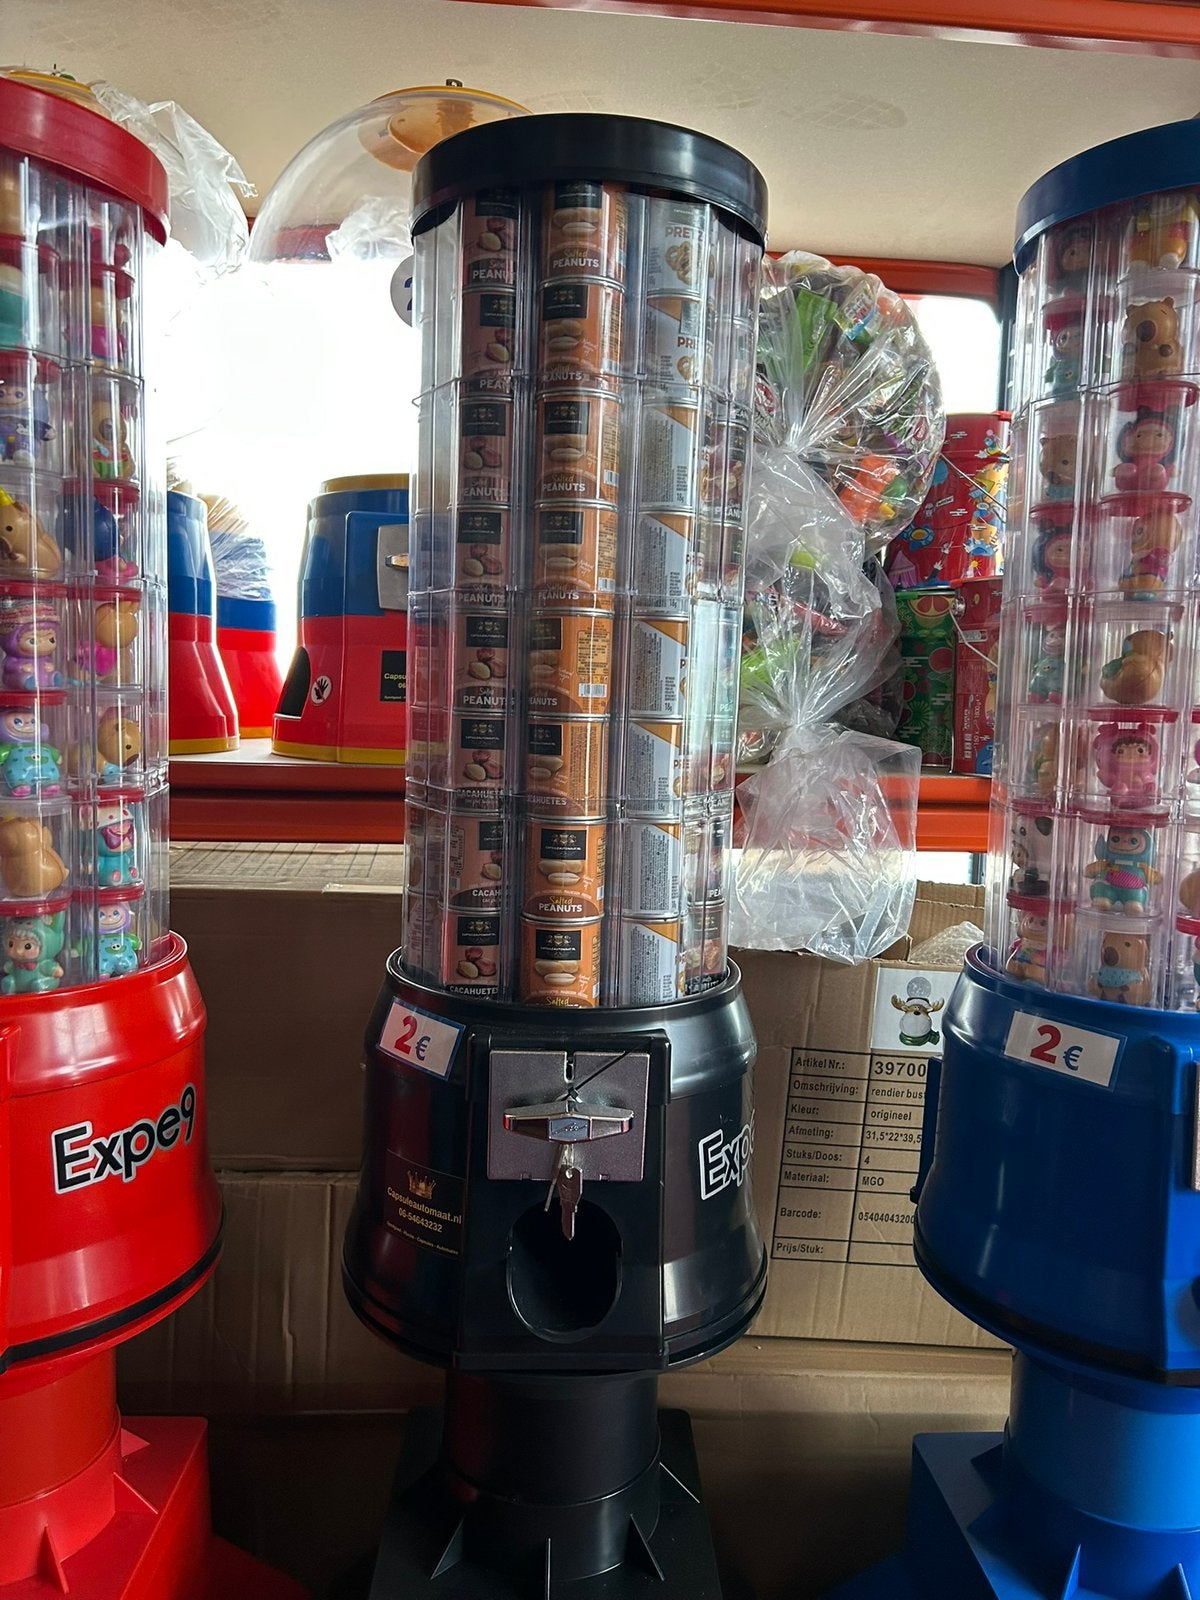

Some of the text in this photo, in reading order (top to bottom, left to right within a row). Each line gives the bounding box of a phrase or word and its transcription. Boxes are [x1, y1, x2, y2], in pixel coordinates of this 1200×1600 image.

[553, 258, 600, 268] PEANUTS
[543, 482, 586, 492] PEANUTS
[538, 902, 583, 913] PEANUTS
[795, 1056, 846, 1070] Artikel Nr.:
[874, 1061, 926, 1078] 39700
[793, 1079, 859, 1096] Omschrijving:
[871, 1087, 925, 1100] rendier bus
[790, 1103, 820, 1115] Kleur:
[870, 1109, 912, 1122] origineel
[788, 1125, 834, 1139] Afmeting:
[786, 1148, 843, 1162] Stuks/Doos:
[863, 1155, 870, 1165] 4
[784, 1170, 830, 1183] Materiaal:
[862, 1176, 885, 1187] MGO
[387, 1186, 462, 1225] Capsuleautomaat.nl
[780, 1207, 822, 1219] Barcode:
[776, 1242, 824, 1254] Prijs/Stuk:
